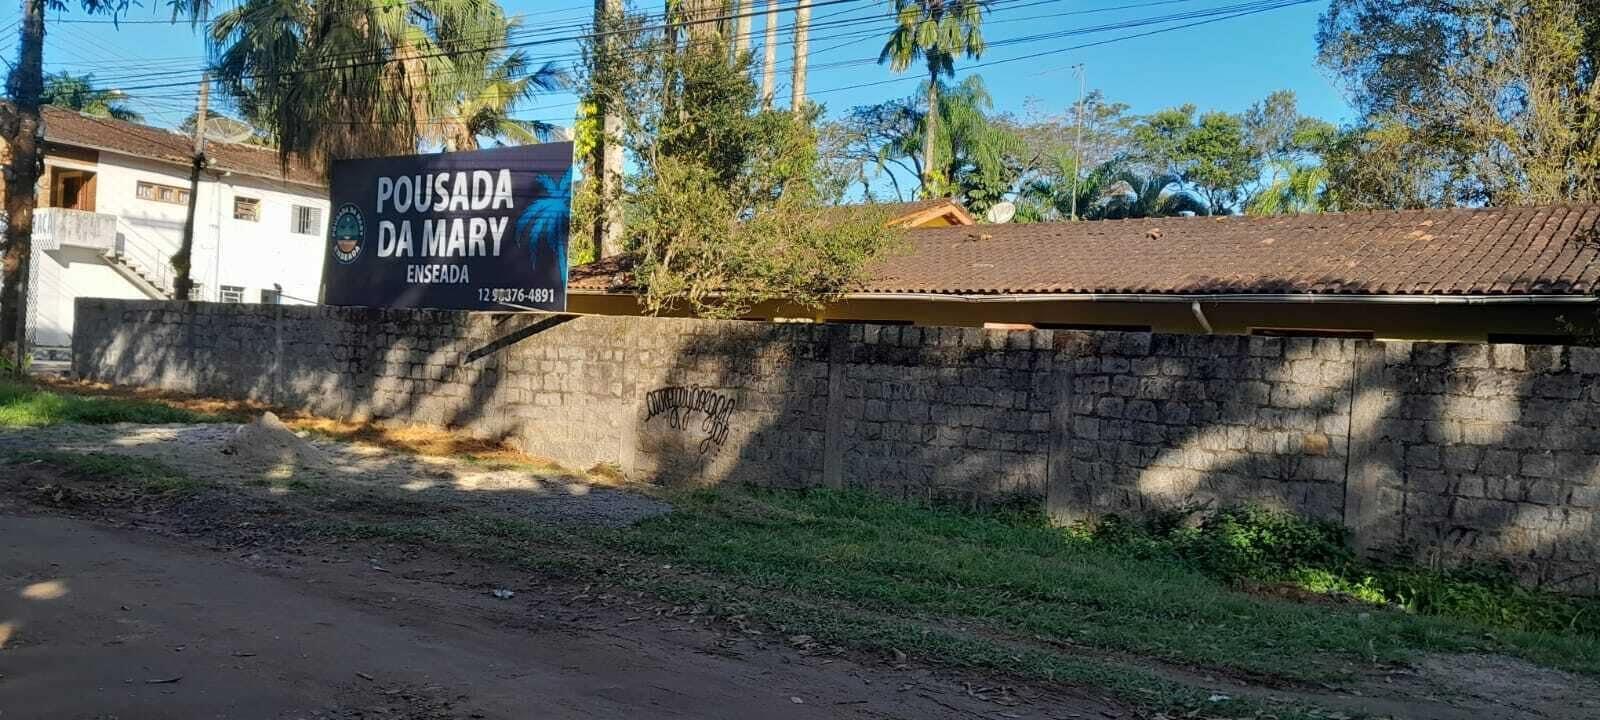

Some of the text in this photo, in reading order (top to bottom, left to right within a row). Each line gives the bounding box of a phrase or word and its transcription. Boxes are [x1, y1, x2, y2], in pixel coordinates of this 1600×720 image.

[376, 169, 514, 214] POUSADA
[377, 216, 510, 258] DA MARY
[406, 264, 470, 284] ENSEADA
[478, 288, 490, 302] 12
